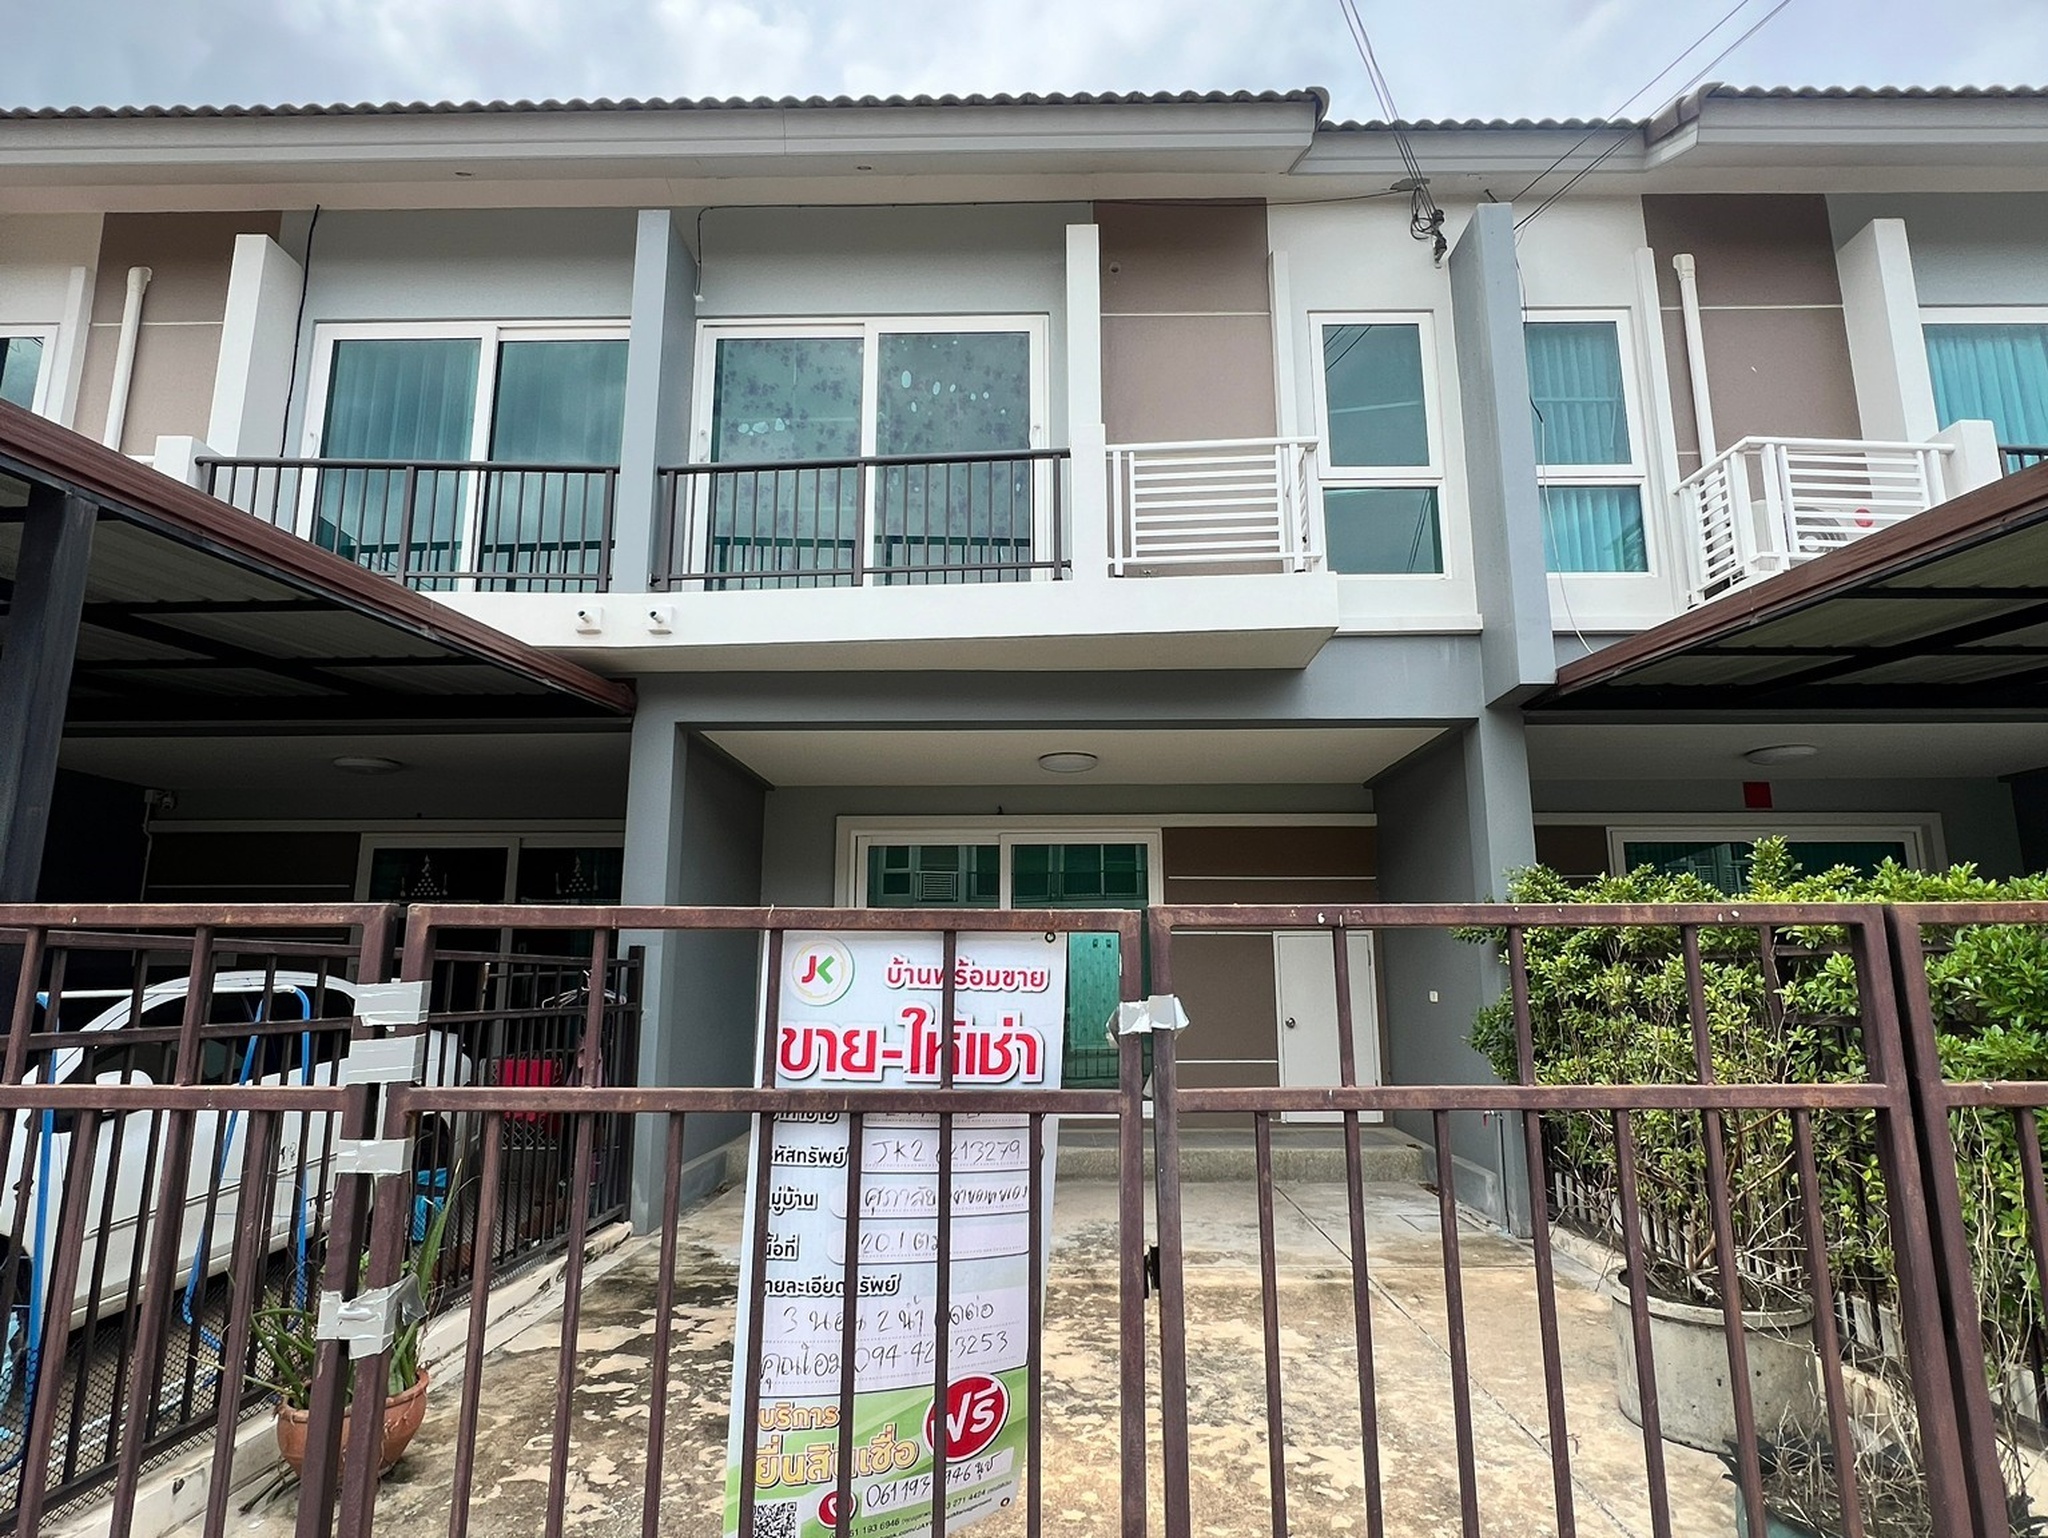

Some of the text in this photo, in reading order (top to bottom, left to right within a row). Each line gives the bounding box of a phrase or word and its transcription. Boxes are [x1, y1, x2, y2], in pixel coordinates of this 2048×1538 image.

[801, 955, 835, 985] JK
[773, 1145, 846, 1164] หัสทรัพย์
[771, 1186, 814, 1212] มู่บ้าน
[764, 1274, 899, 1294] ายละเอียดรัพย์
[877, 1309, 893, 1332] 2
[759, 1403, 839, 1429] บริการ
